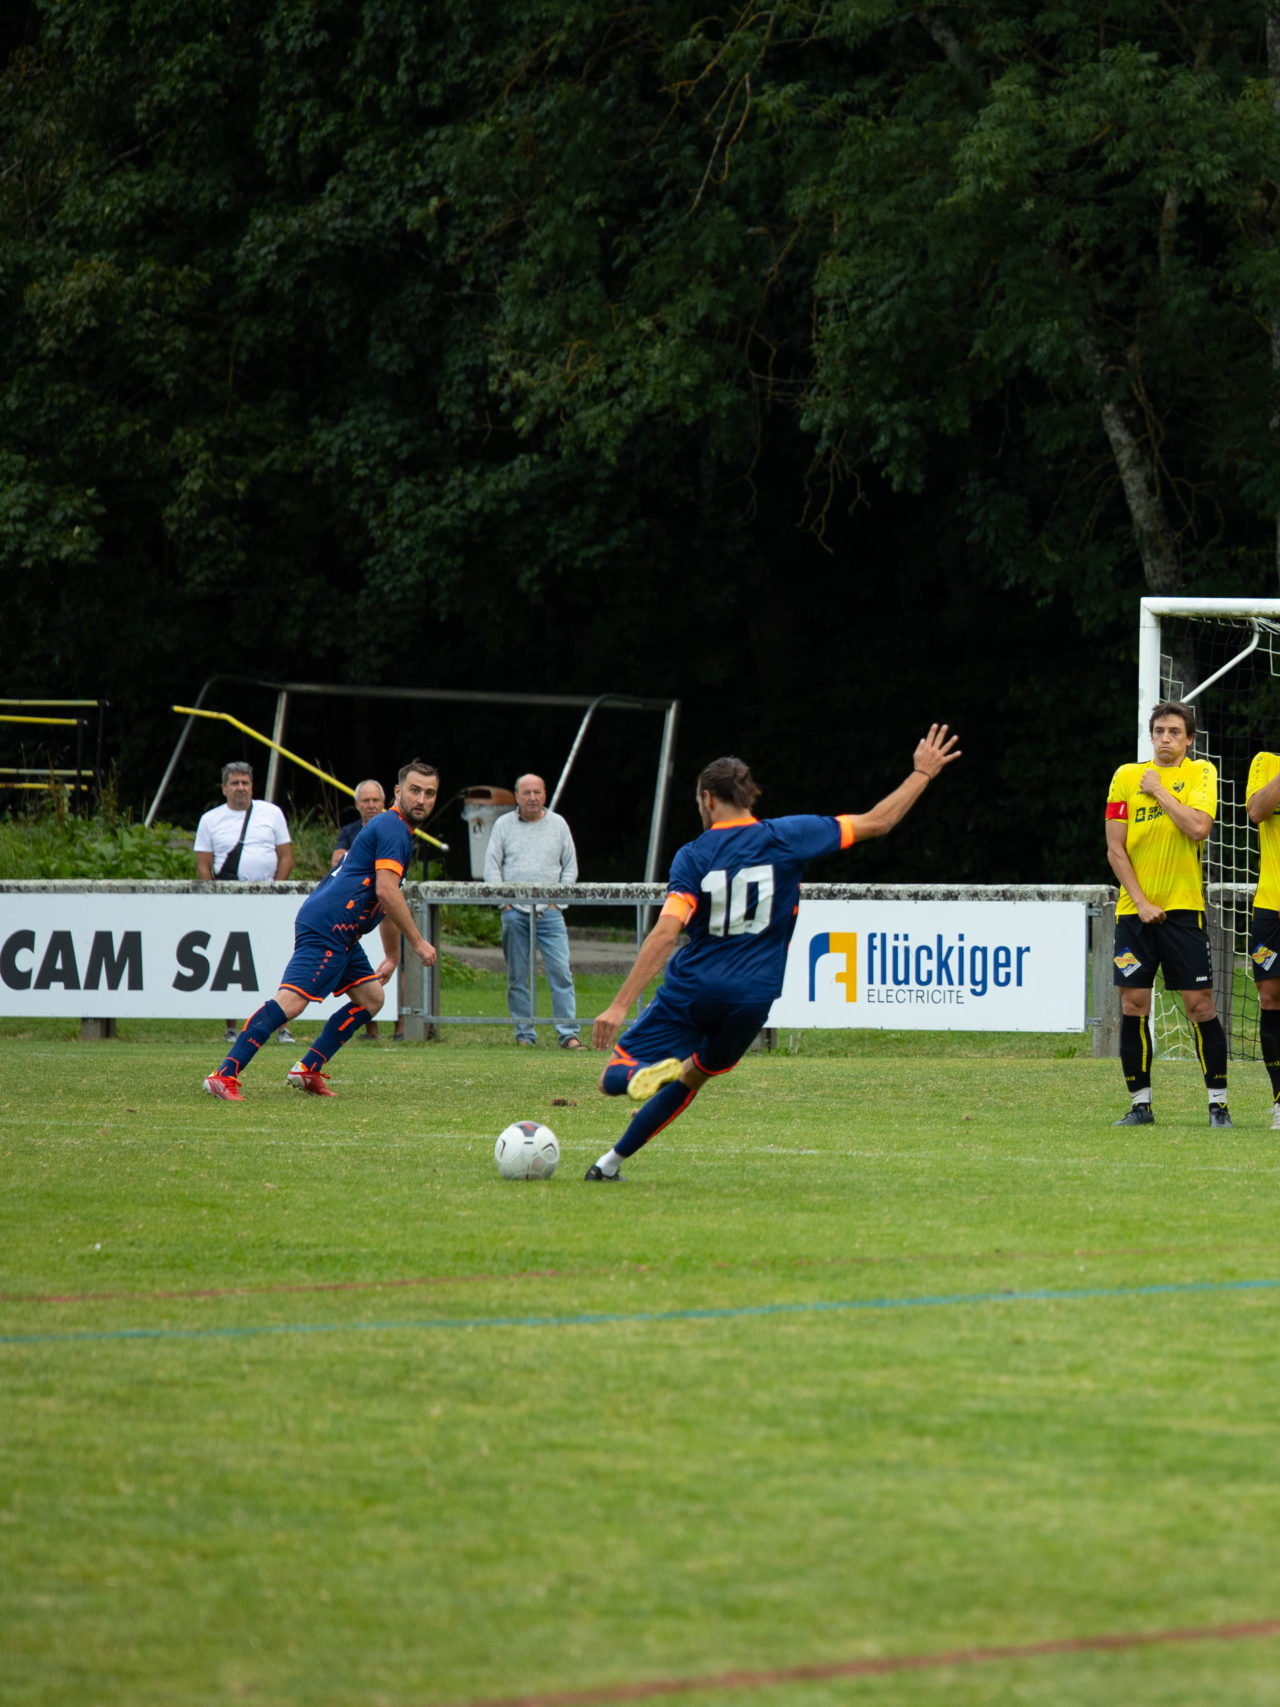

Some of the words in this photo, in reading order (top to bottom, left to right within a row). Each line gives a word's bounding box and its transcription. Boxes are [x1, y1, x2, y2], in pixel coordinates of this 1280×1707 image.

[700, 864, 774, 937] 10
[0, 929, 144, 991] CAM
[172, 930, 260, 992] SA
[867, 932, 1031, 997] flückiger
[867, 988, 965, 1005] ELECTRICITE
